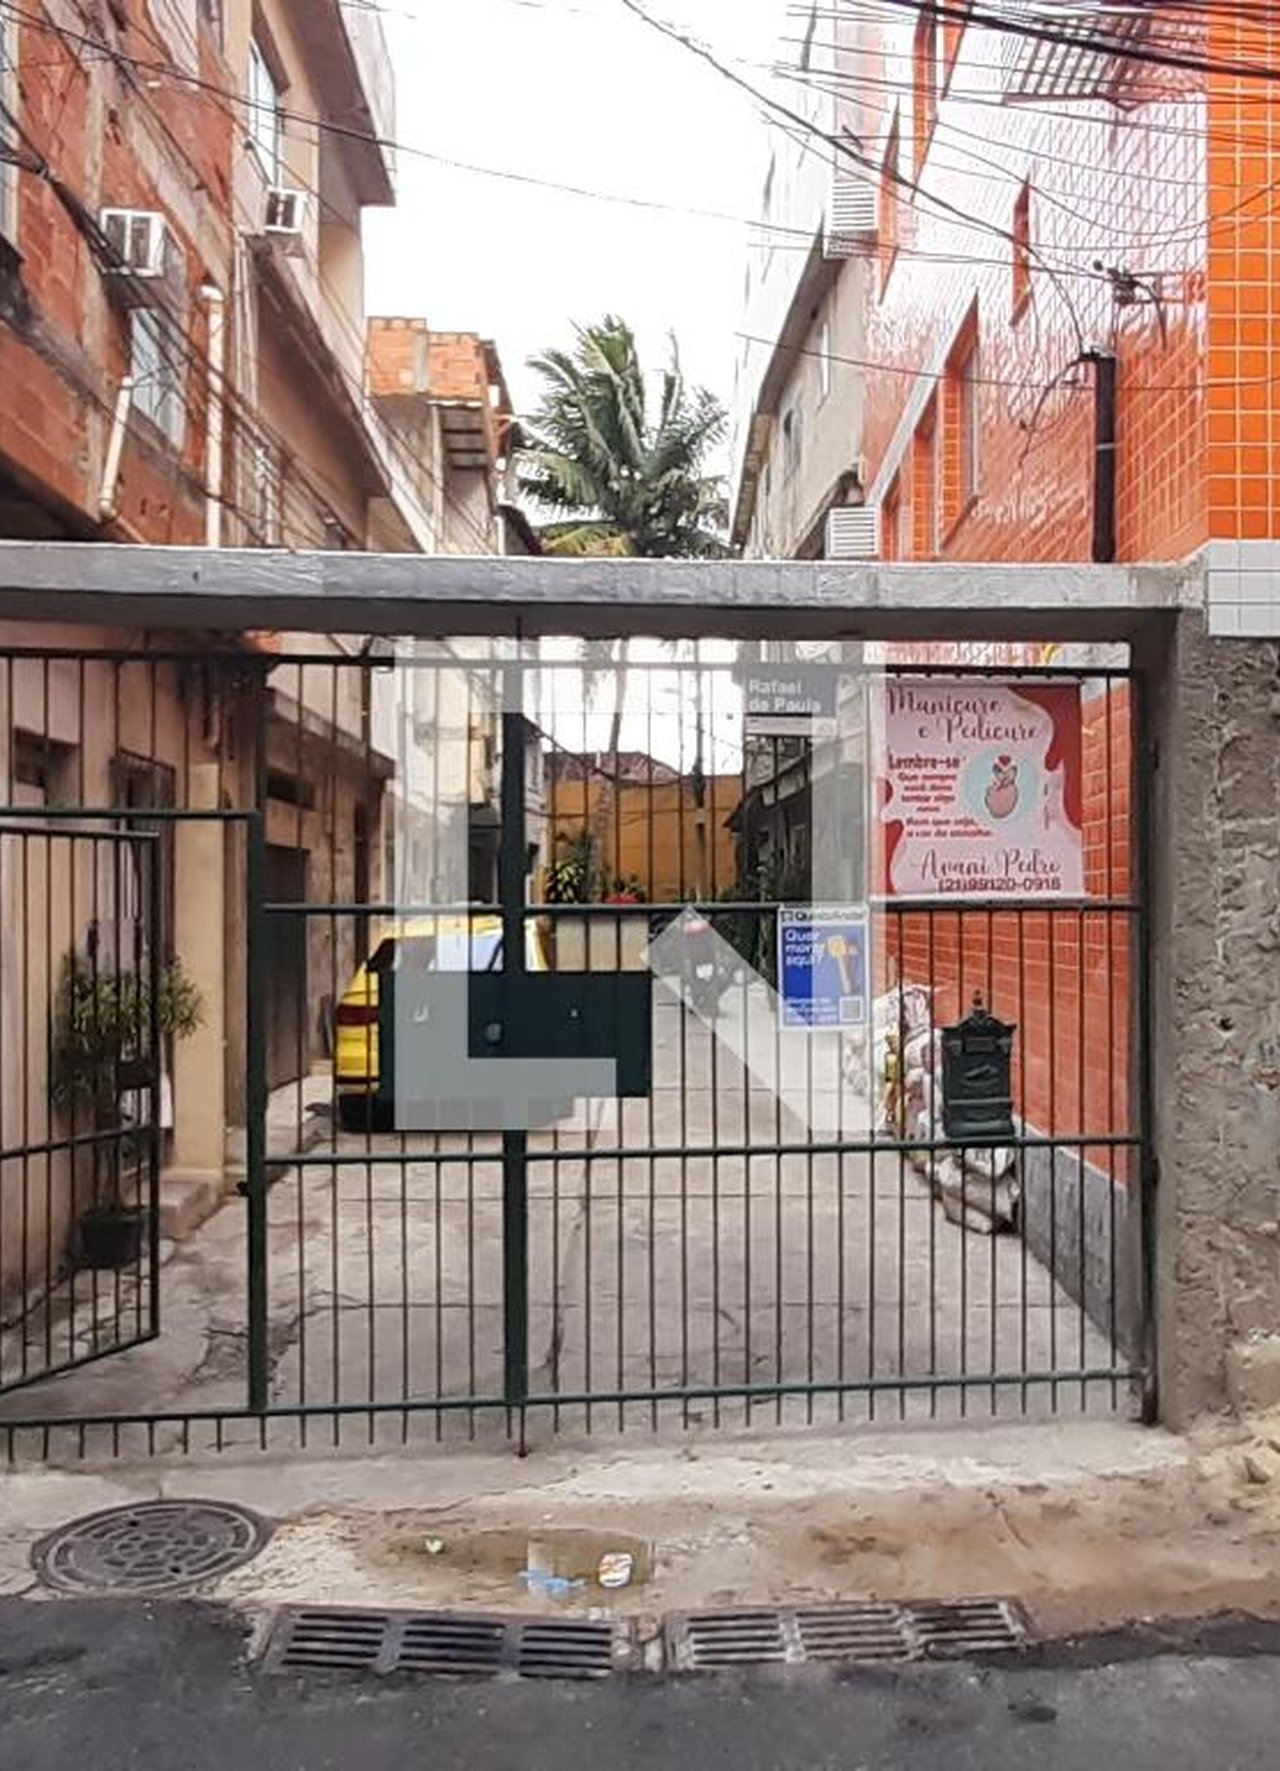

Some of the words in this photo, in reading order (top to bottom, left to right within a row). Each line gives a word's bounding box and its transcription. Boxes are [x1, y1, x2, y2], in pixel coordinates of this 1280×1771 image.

[749, 678, 802, 694] Rafael
[774, 696, 822, 712] Paula
[888, 684, 1002, 716] Manicure
[919, 725, 929, 739] e
[937, 716, 1039, 743] Pedicure
[916, 849, 990, 880] Avani
[1001, 848, 1061, 875] Pedro
